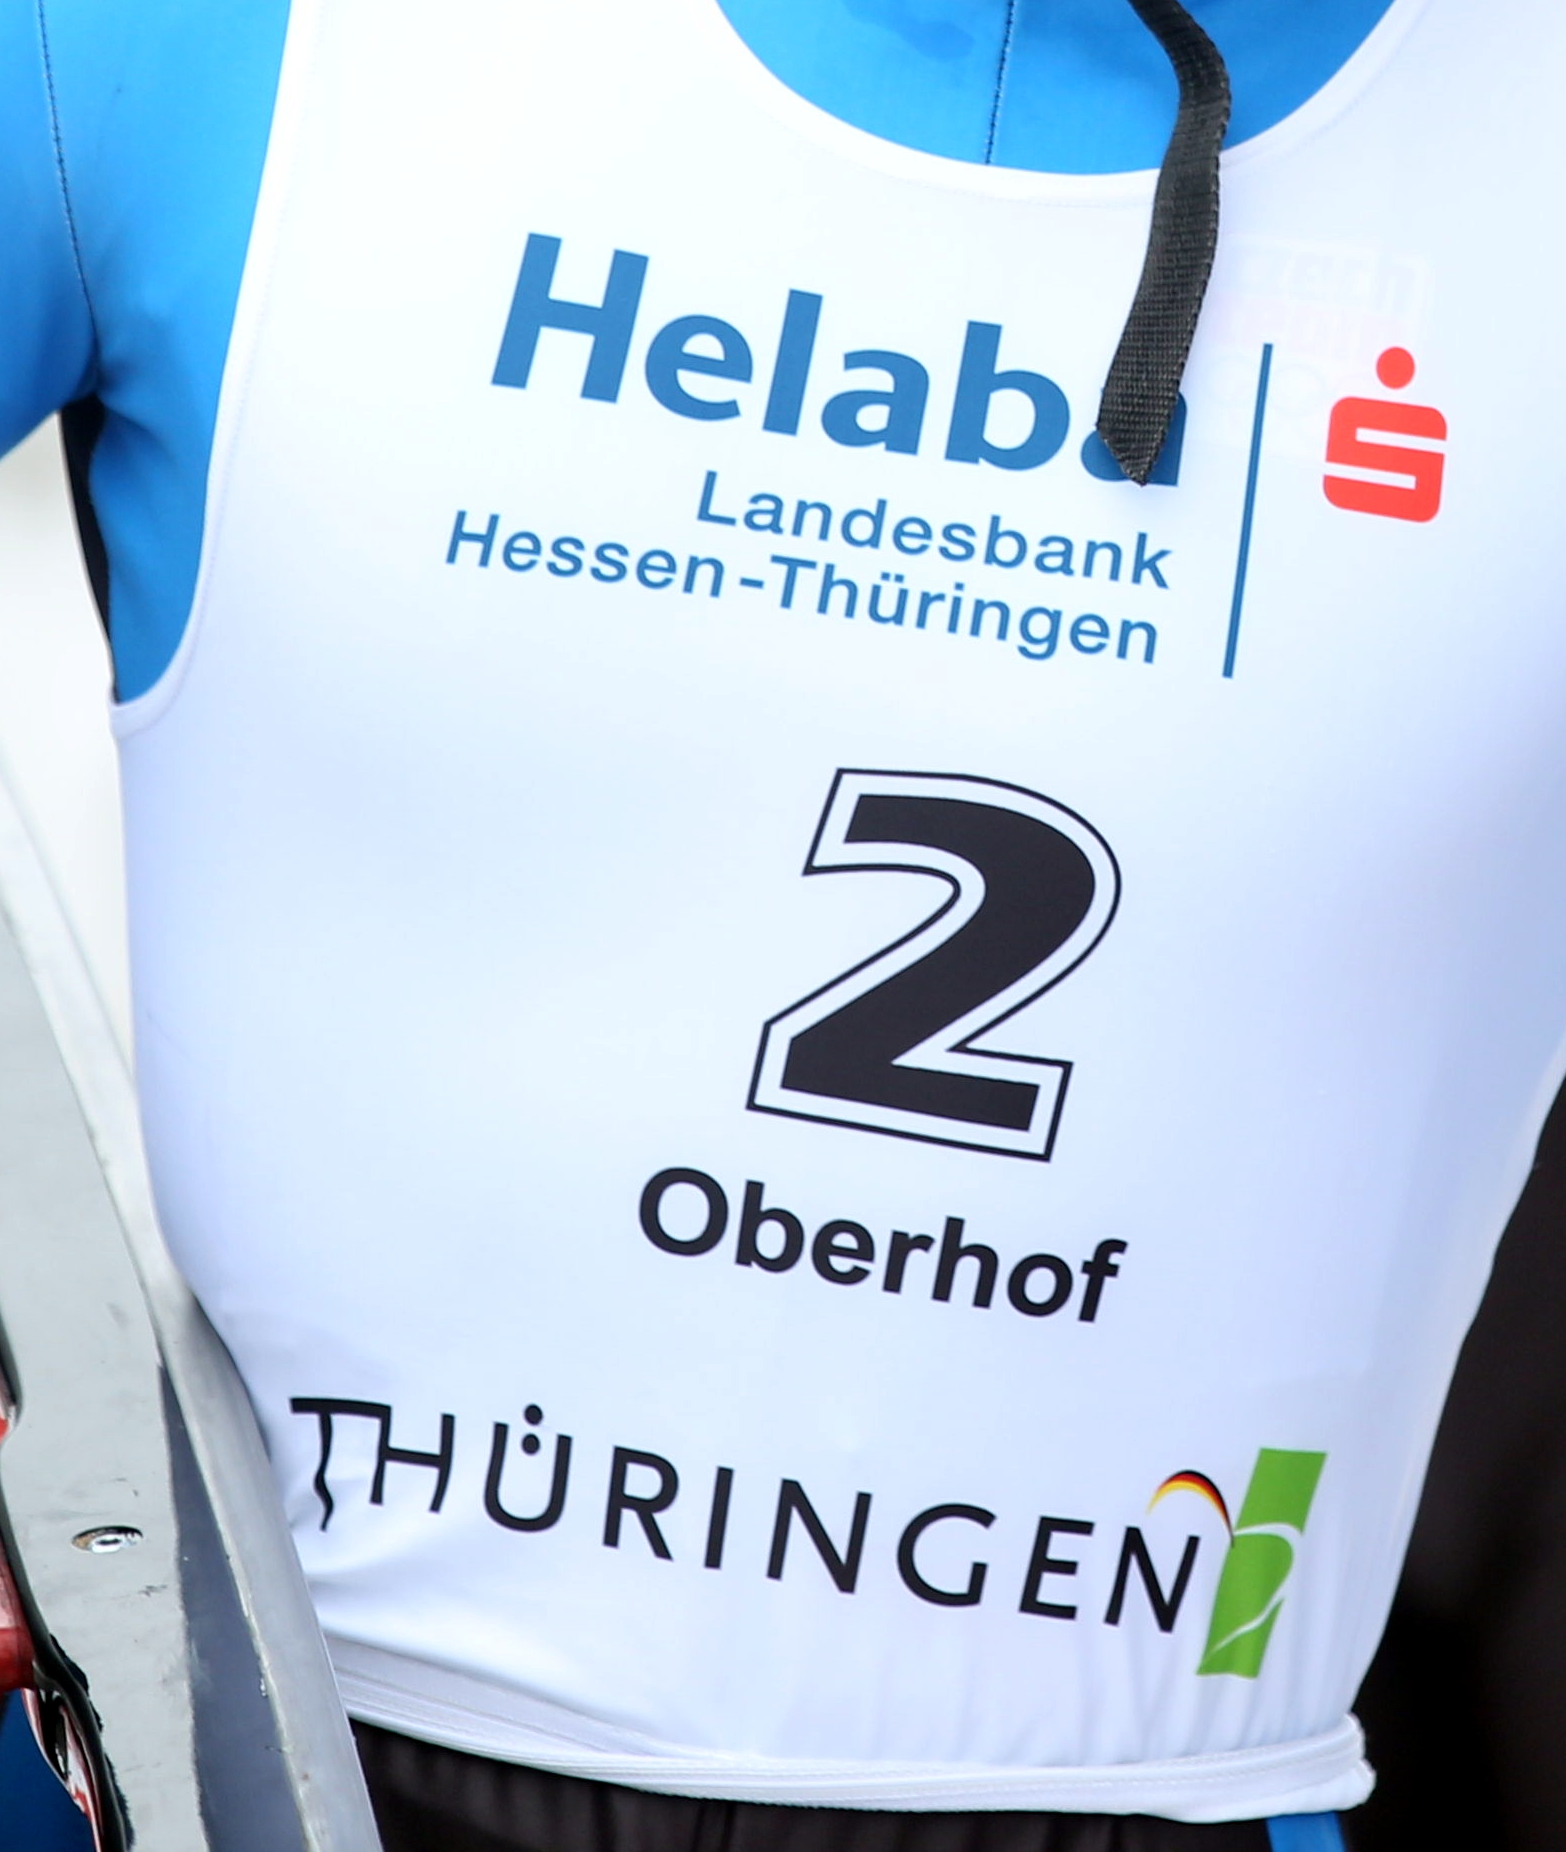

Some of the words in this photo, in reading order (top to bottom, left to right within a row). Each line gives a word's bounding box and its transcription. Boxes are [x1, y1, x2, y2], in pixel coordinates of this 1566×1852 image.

[445, 510, 1158, 664] Hessen-Thüringen
[696, 470, 1172, 590] Landesbank
[746, 767, 1122, 1163] 2
[639, 1167, 1128, 1323] Oberhof
[289, 1396, 1201, 1634] THÜRINGEN
